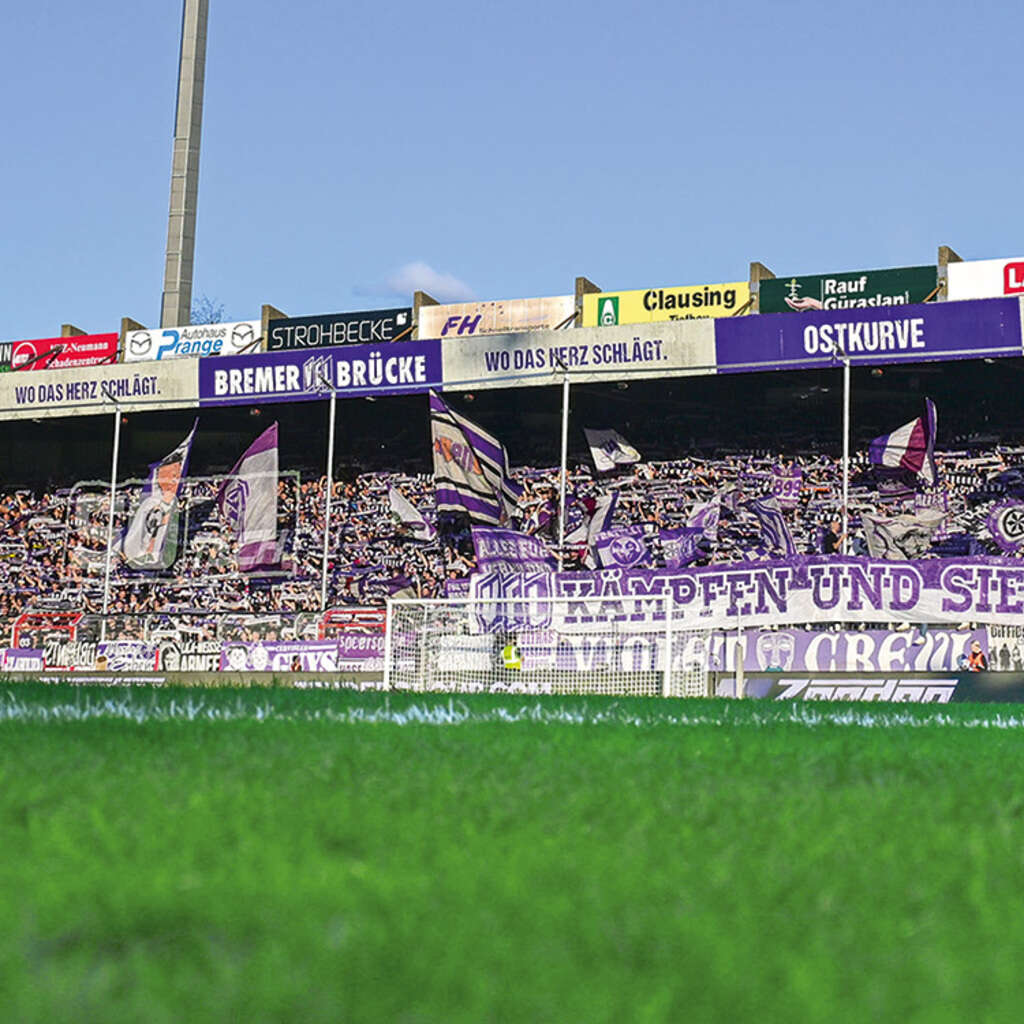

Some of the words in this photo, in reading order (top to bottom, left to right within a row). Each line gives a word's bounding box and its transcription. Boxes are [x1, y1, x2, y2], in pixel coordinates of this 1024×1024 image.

[643, 287, 737, 311] Clausing
[824, 276, 868, 294] Rauf
[180, 328, 227, 340] Autohaus
[271, 317, 394, 350] STROHBECKE
[440, 314, 482, 336] FH
[803, 318, 926, 354] OSTKURVE
[156, 330, 224, 360] Prange
[485, 350, 510, 372] WO
[514, 347, 546, 370] DAS
[550, 343, 589, 367] HERZ
[591, 340, 668, 365] SCHLÄGT.
[214, 365, 300, 395] BREMER
[337, 351, 426, 388] BRÜCKE
[16, 385, 37, 404] WO
[38, 383, 64, 403] DAS
[66, 380, 98, 401] HERZ
[100, 375, 162, 399] SCHLÄGT.
[560, 569, 789, 624] KÄMPFEN
[811, 567, 924, 613] UND
